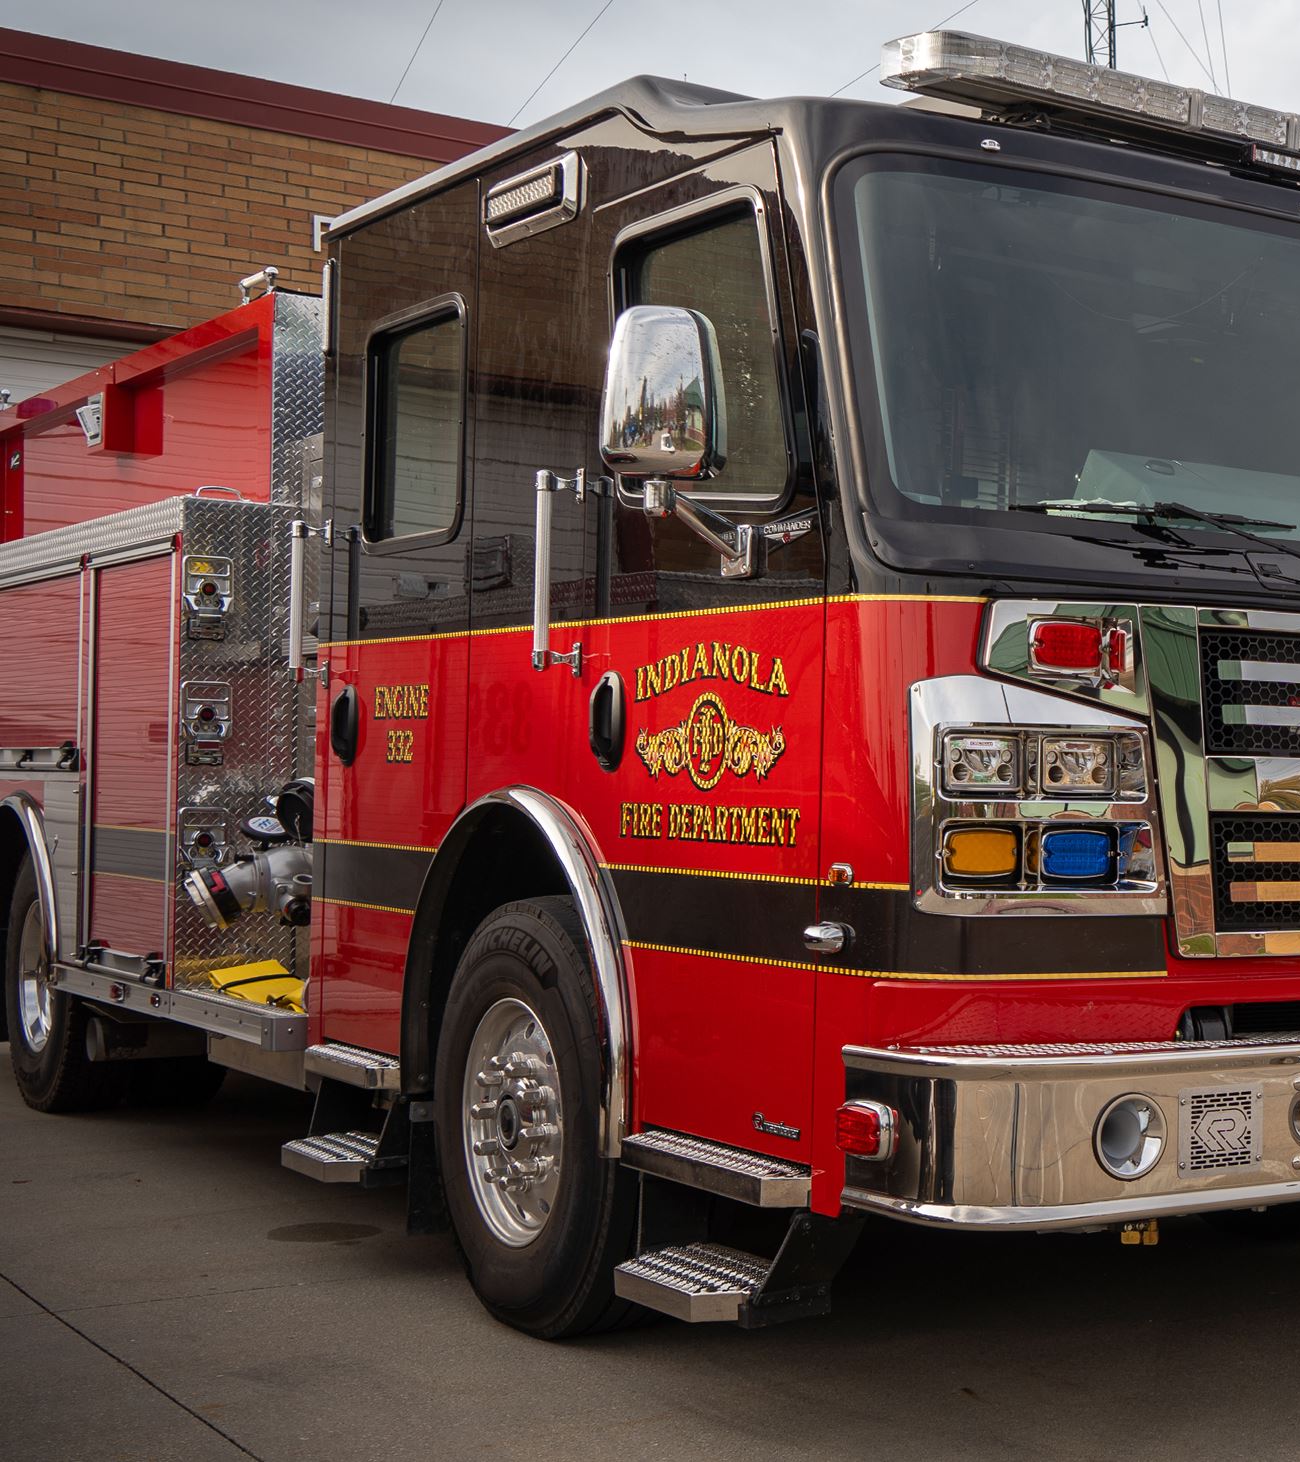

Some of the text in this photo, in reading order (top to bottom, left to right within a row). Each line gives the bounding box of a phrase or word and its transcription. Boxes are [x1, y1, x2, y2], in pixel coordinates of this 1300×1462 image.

[763, 520, 811, 534] COMMANDER
[635, 641, 789, 702] INDIANOLA
[374, 684, 429, 720] ENGINE
[386, 730, 415, 763] 332
[620, 803, 801, 847] FIRE DEPARTMENT
